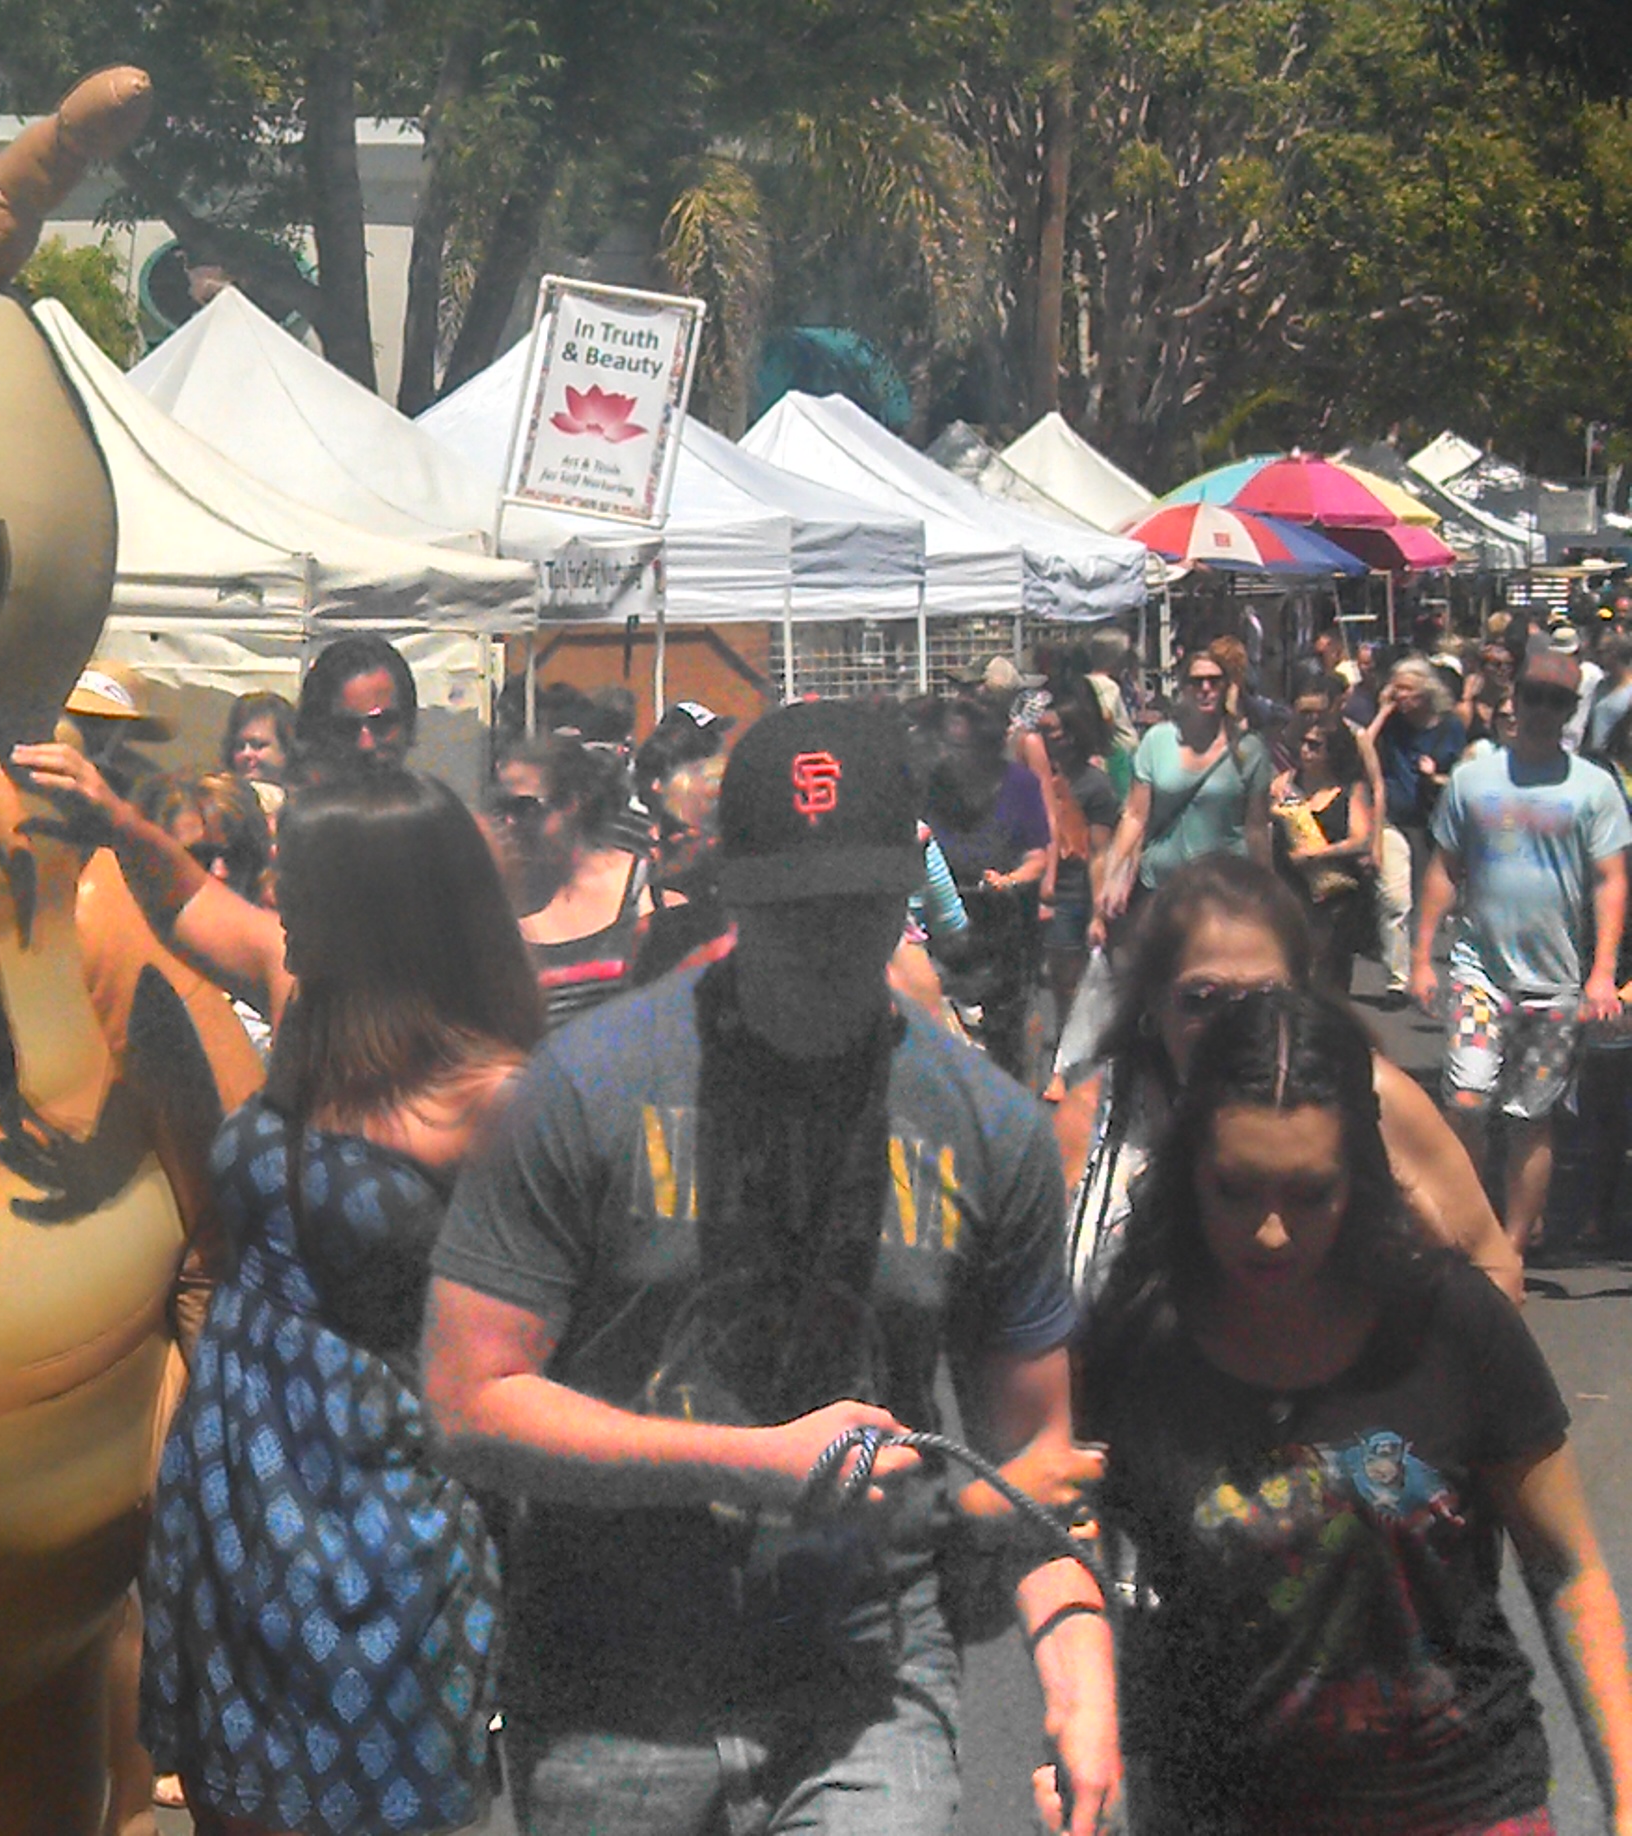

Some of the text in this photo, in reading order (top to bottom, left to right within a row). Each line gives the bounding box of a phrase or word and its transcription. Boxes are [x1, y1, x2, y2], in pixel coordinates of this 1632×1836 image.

[574, 317, 659, 350] In Truth
[561, 341, 664, 380] & Beauty
[792, 750, 843, 825] SF
